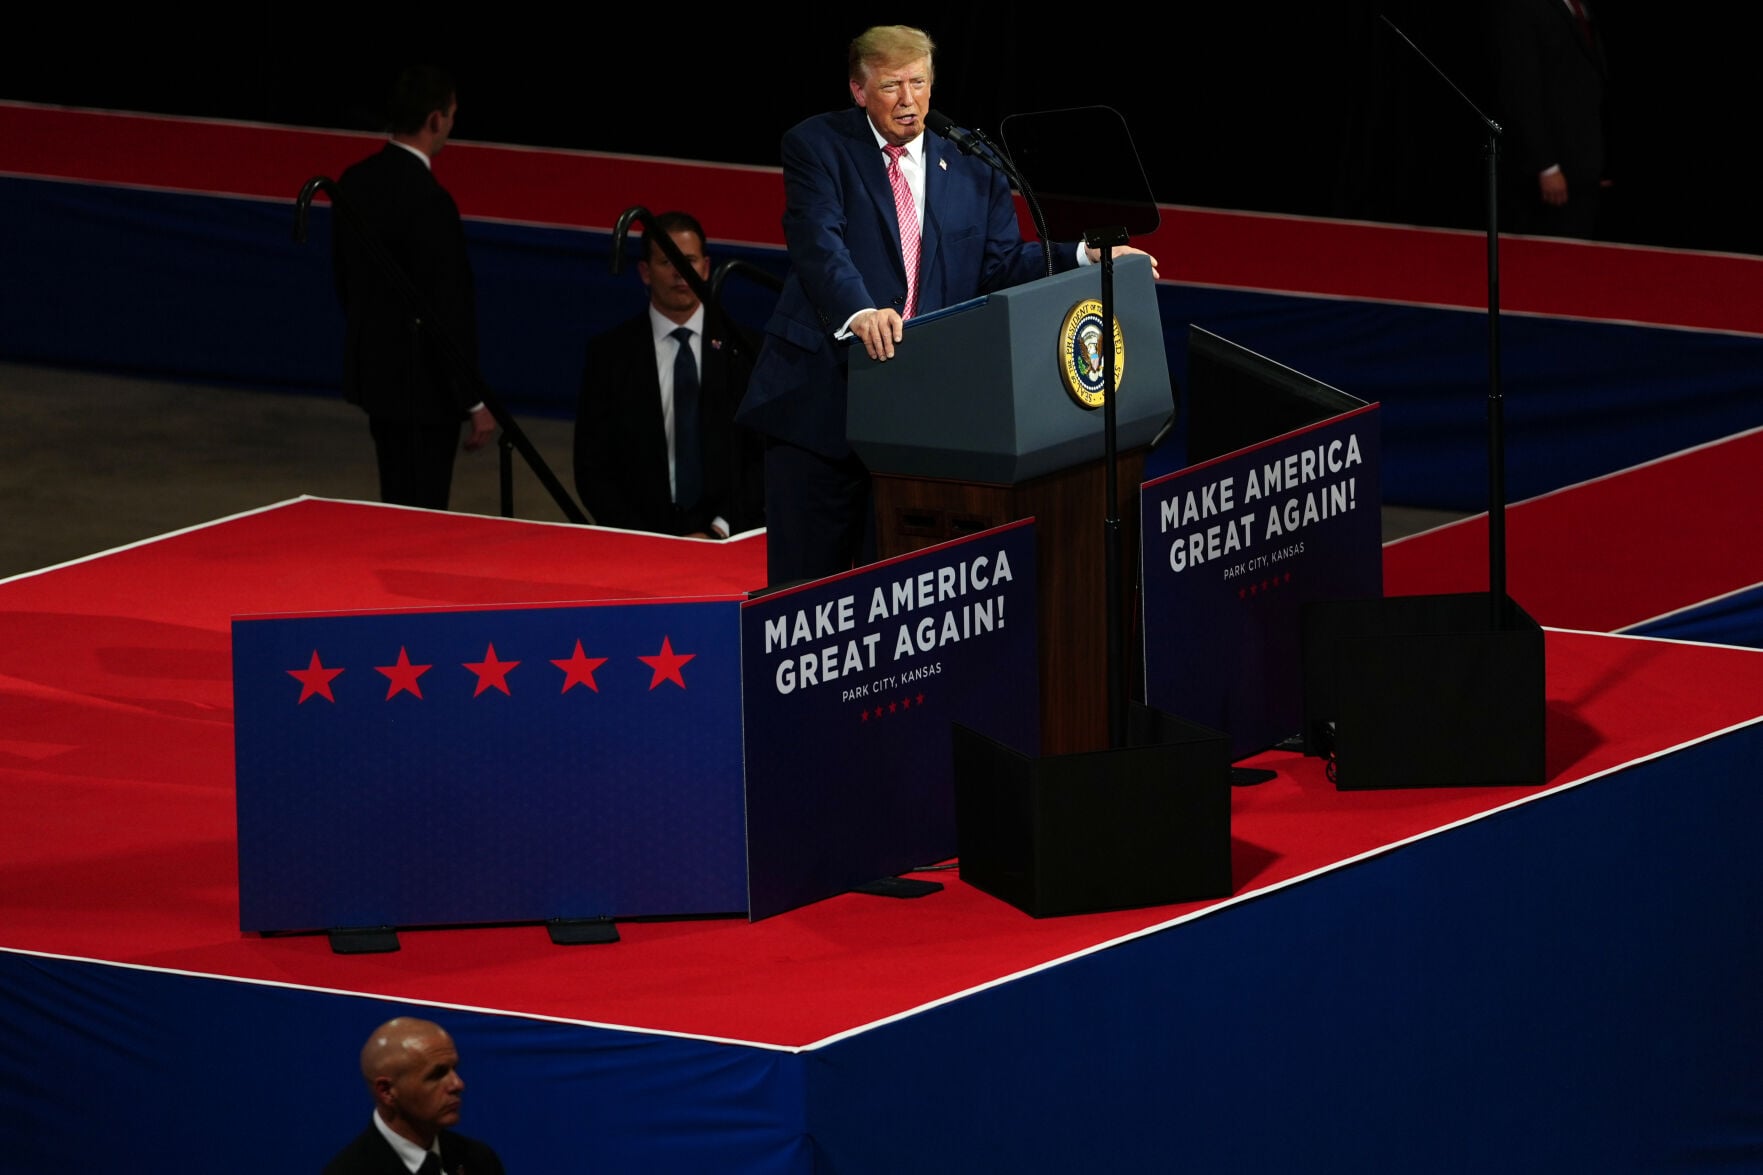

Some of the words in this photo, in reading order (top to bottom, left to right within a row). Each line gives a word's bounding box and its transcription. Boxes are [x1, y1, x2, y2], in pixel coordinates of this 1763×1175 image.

[1066, 304, 1089, 355] PRESIDENT
[1161, 476, 1235, 534] MAKE
[1245, 433, 1363, 505] AMERICA
[1169, 512, 1256, 573] GREAT
[1266, 476, 1356, 541] AGAIN!
[764, 594, 856, 655] MAKE
[868, 549, 1014, 624] AMERICA
[1223, 562, 1246, 581] PARK
[1249, 554, 1269, 572] CITY,
[1271, 541, 1305, 563] KANSAS
[775, 632, 881, 695] GREAT
[893, 594, 1005, 661] AGAIN!
[842, 683, 869, 703] PARK
[872, 675, 898, 693] CITY,
[901, 661, 942, 685] KANSAS
